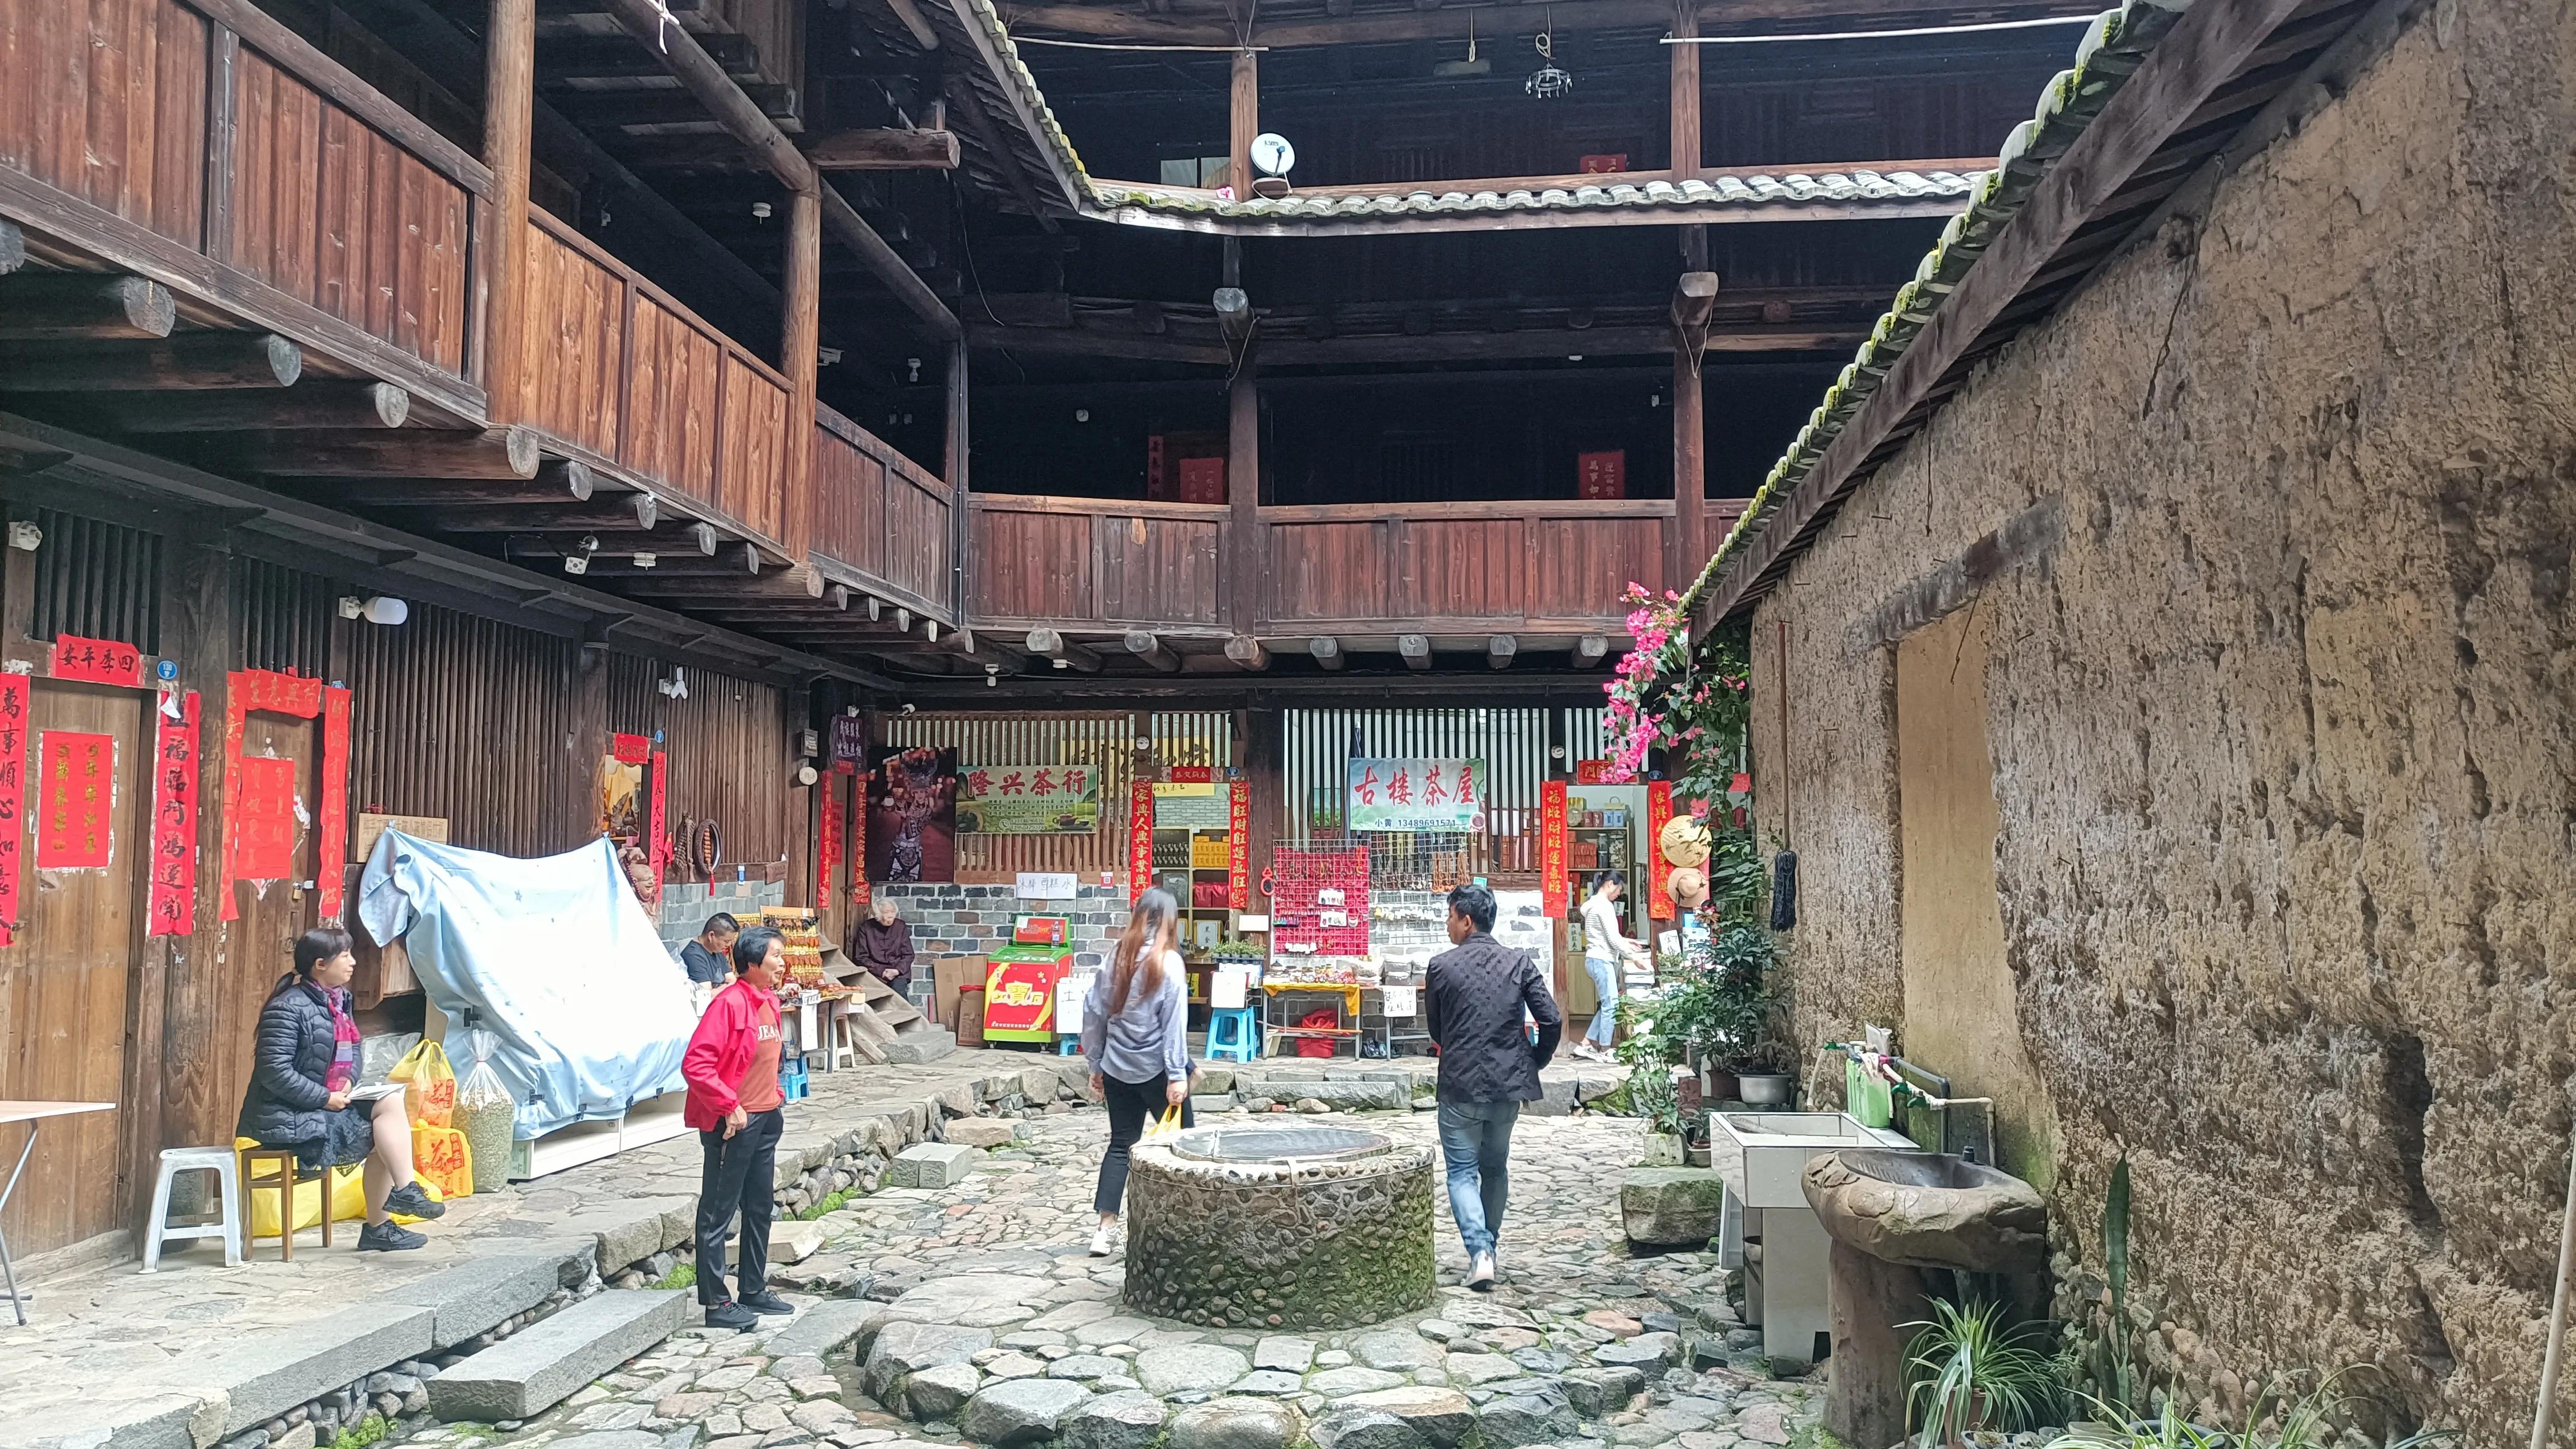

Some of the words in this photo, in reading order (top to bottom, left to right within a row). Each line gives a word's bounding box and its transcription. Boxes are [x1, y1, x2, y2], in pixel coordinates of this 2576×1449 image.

[968, 768, 1087, 797] 隆兴茶行
[1354, 764, 1475, 807] 古楼茶屋
[1375, 818, 1393, 827] 小黄
[1398, 819, 1456, 827] 13489691571
[1062, 877, 1074, 890] 水
